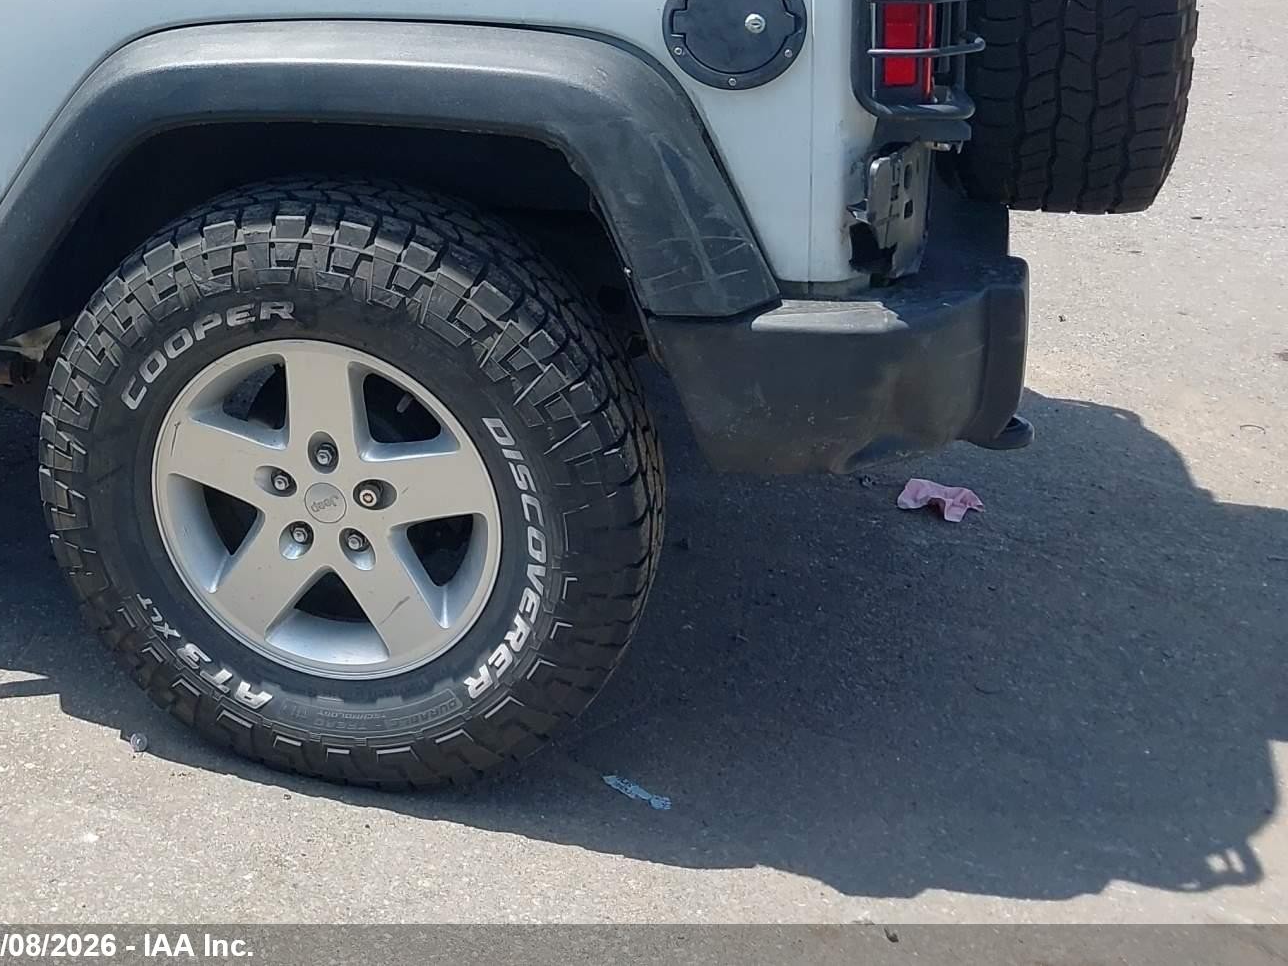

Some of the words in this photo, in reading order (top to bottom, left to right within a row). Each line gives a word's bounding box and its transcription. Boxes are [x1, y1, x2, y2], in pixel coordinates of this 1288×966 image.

[120, 301, 295, 410] COOPER
[462, 417, 545, 700] DISCOVERER
[136, 594, 181, 639] XLT
